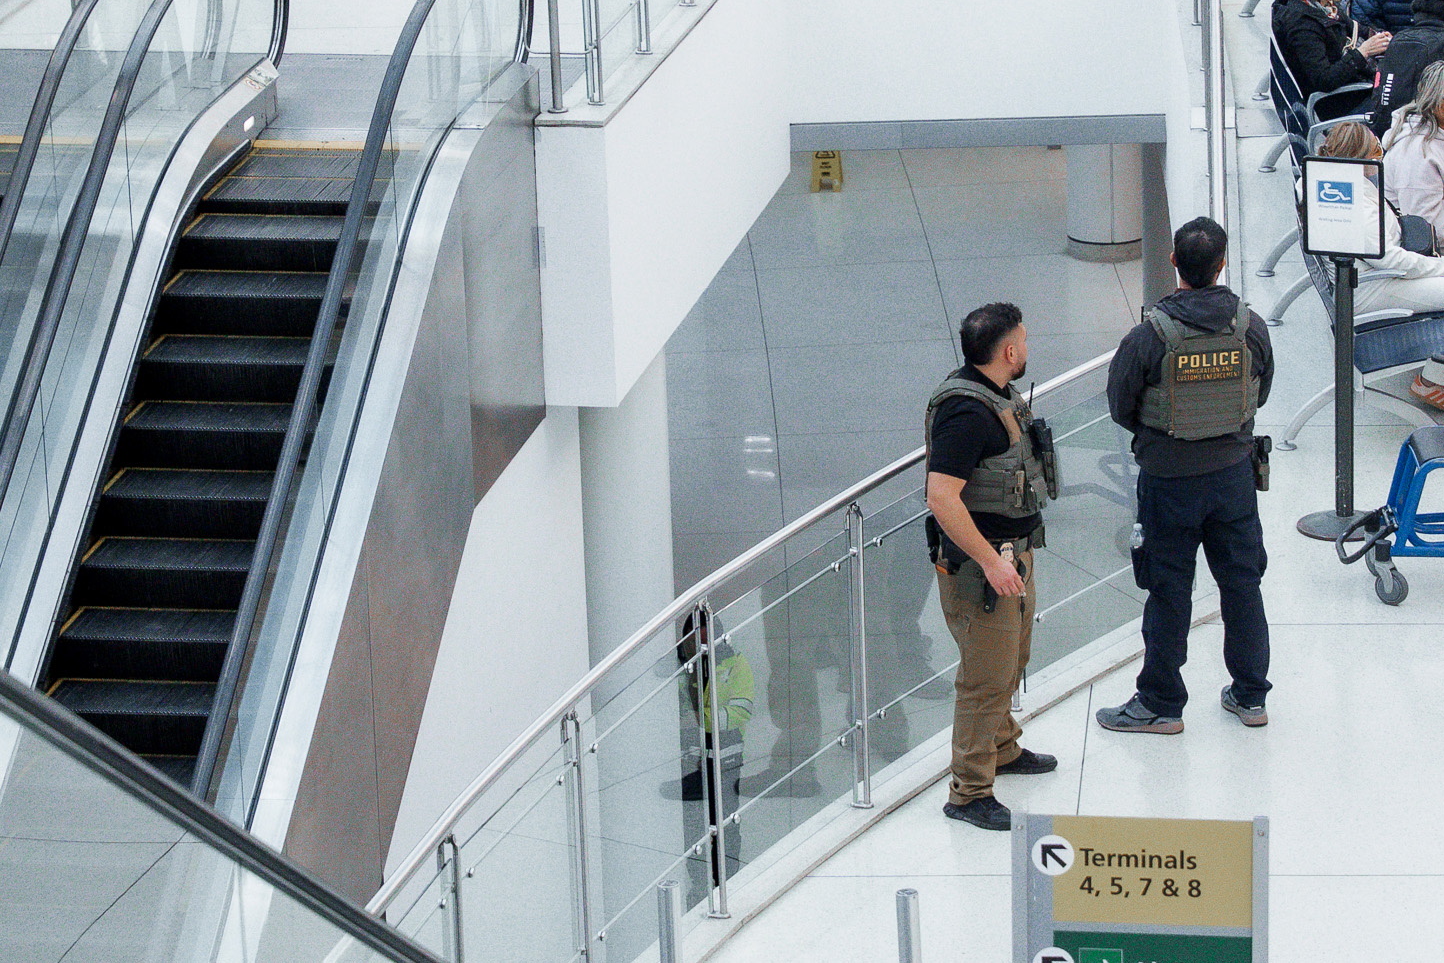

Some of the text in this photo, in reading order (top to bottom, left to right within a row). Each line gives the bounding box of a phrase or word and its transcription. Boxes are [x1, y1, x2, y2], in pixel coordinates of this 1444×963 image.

[1178, 350, 1240, 369] POLICE
[1176, 371, 1240, 382] CUSTOMS ENFORCEMENT
[1182, 367, 1220, 375] IMMIGRATION
[1079, 848, 1197, 870] Terminals
[1079, 876, 1202, 898] 4, 5, 7 & 8
